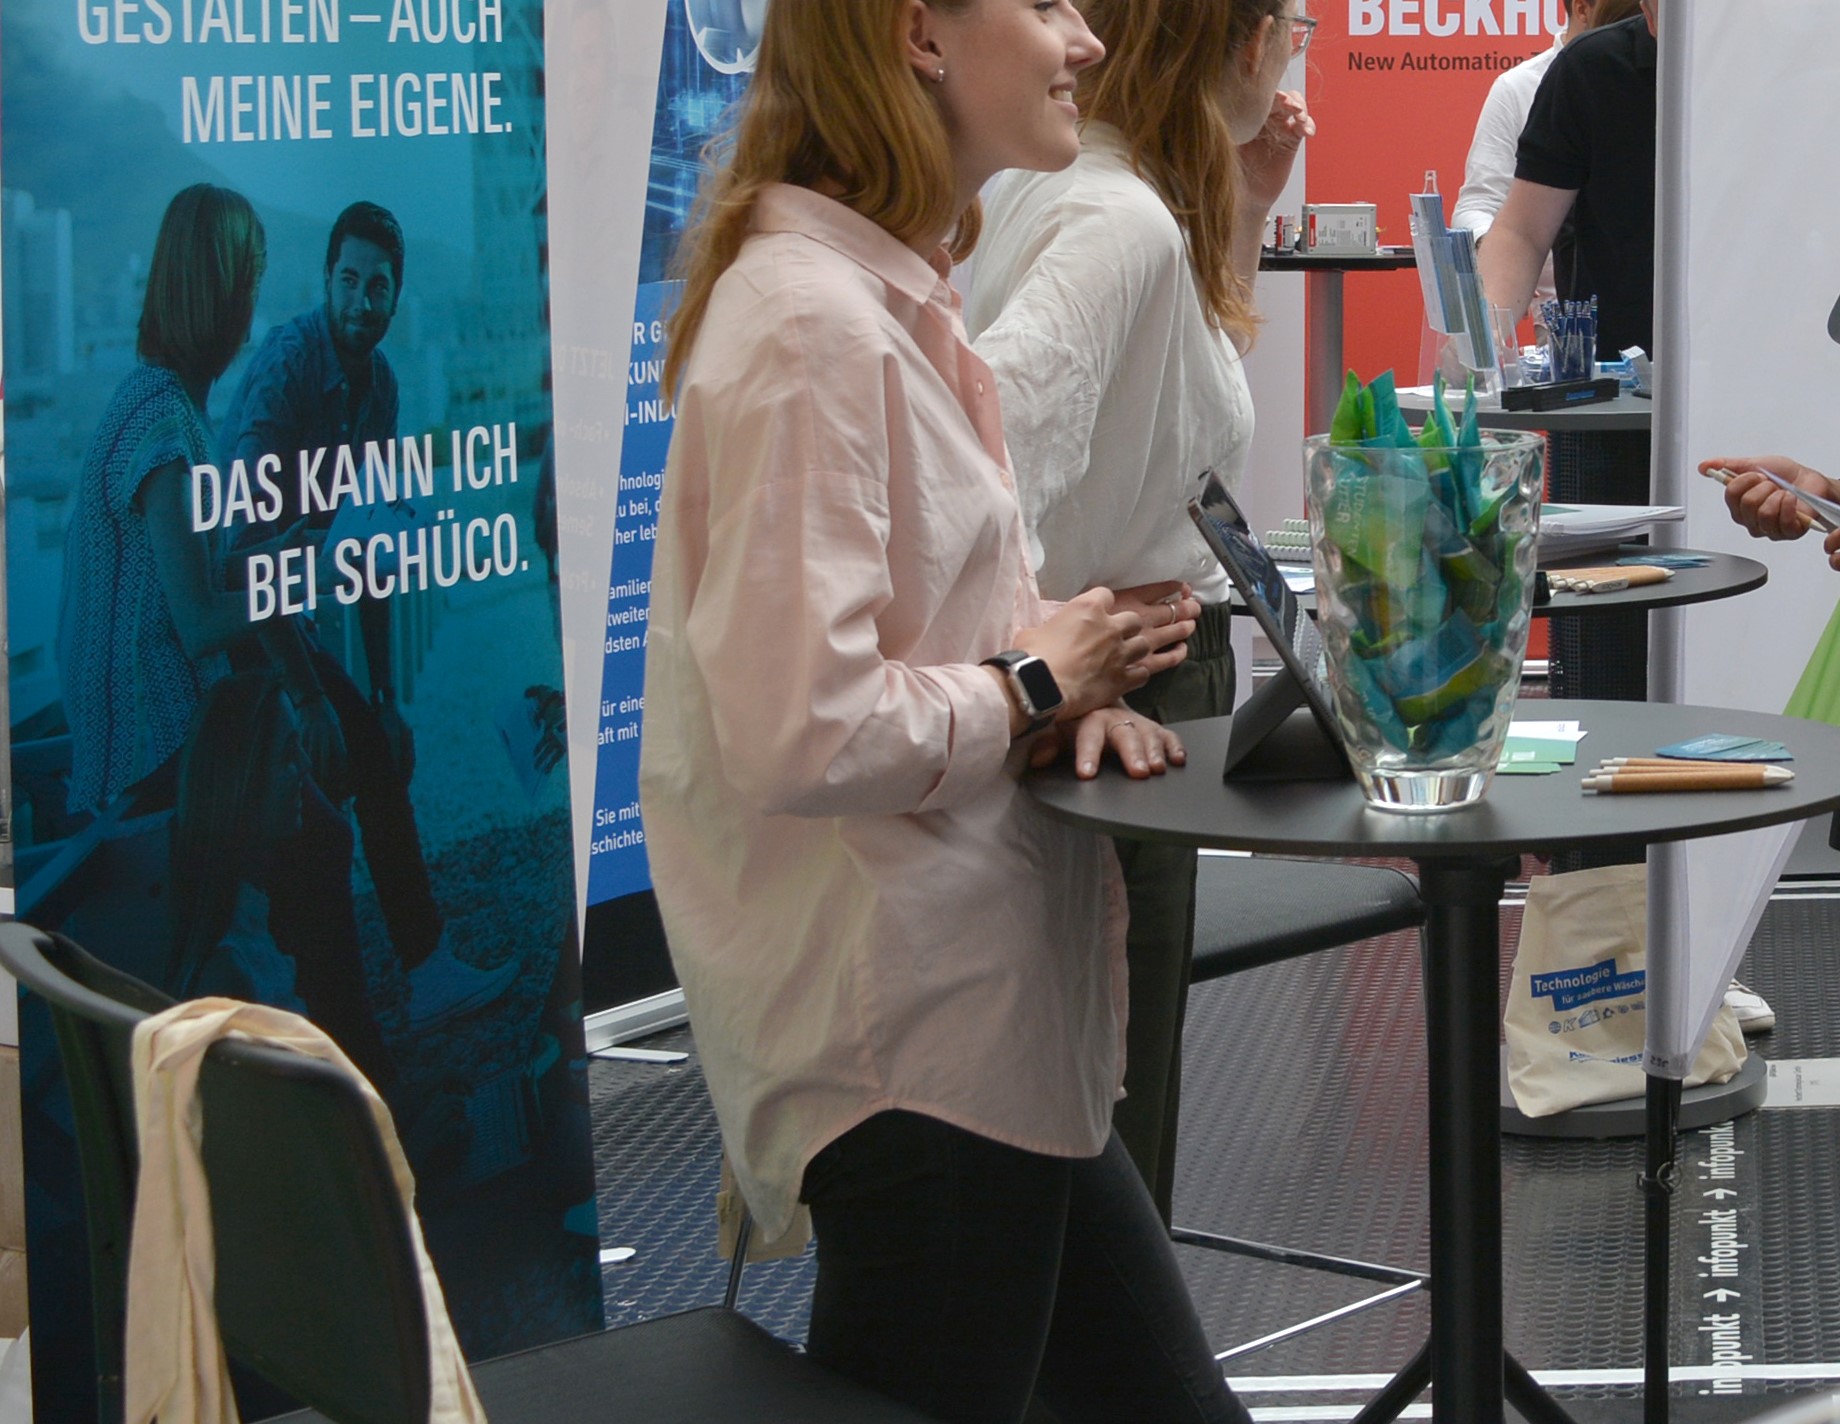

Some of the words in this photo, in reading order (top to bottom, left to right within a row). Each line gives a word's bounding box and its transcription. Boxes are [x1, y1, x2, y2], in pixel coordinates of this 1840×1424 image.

[1347, 51, 1396, 71] New
[182, 74, 333, 143] MEINE
[350, 72, 513, 138] EIGENE.
[191, 453, 284, 533] DAS
[300, 433, 434, 515] KANN
[451, 421, 518, 492] ICH
[629, 497, 652, 517] bei,
[614, 527, 638, 546] her
[248, 544, 317, 623] BEI
[334, 508, 529, 605] SCHÜCO.
[604, 636, 640, 655] dsten
[617, 721, 639, 741] mit
[595, 807, 616, 828] Sie
[618, 802, 641, 820] mit
[1534, 966, 1611, 993] Technologie
[1561, 994, 1575, 1005] für
[1698, 1208, 1749, 1279] infopunkt
